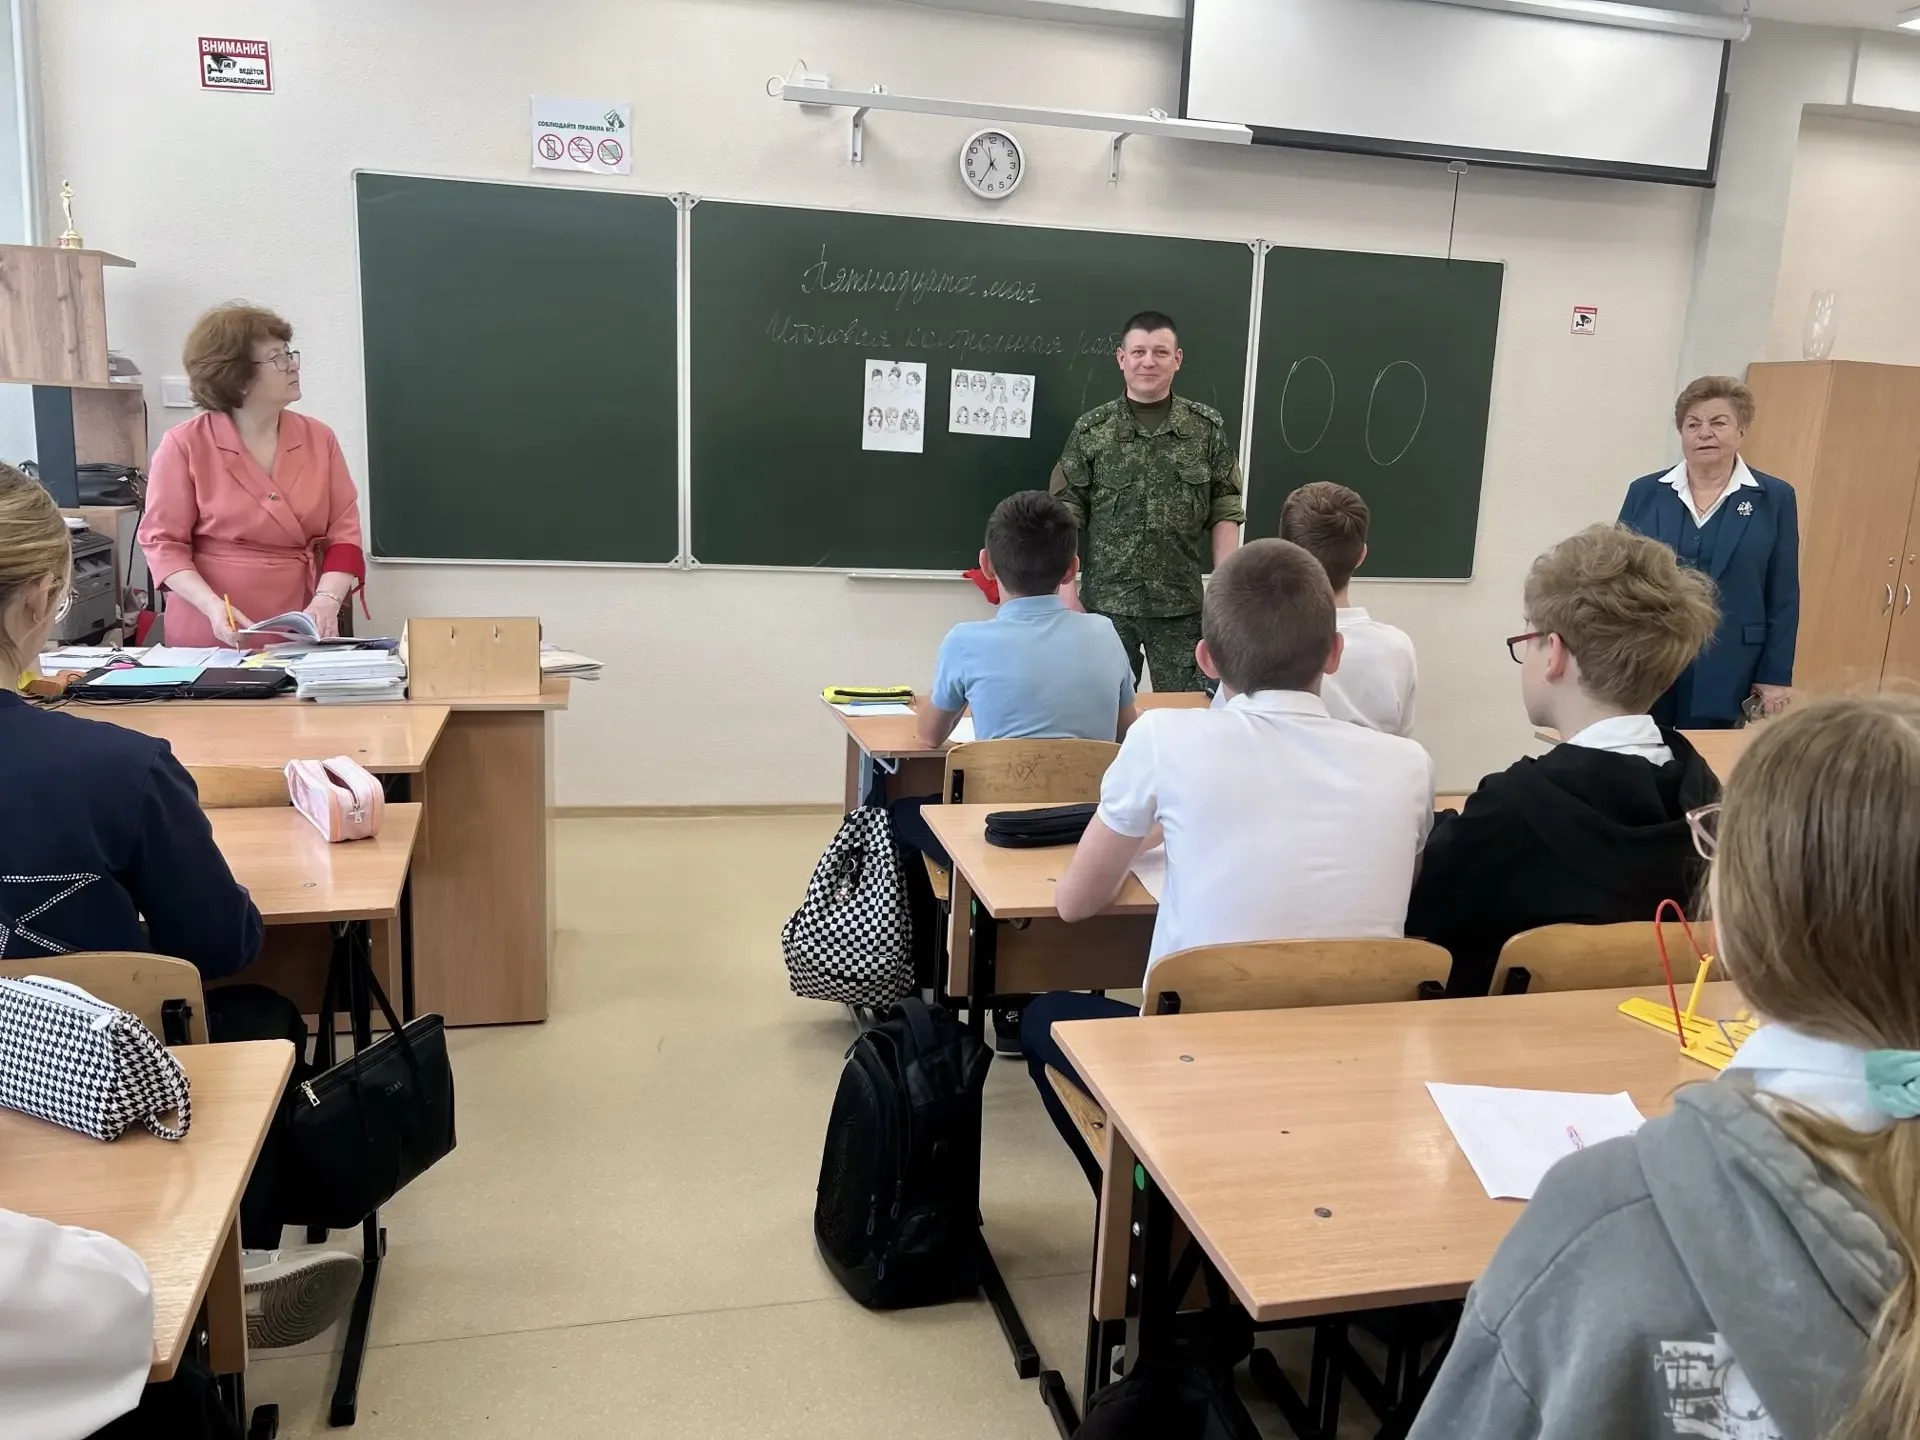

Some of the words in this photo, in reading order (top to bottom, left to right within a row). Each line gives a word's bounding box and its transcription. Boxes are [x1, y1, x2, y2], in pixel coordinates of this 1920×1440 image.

[201, 40, 266, 55] ВНИМАНИЕ
[207, 76, 265, 85] ВИДЕОНАБЛЮДЕНИЕ
[538, 121, 576, 130] СОБЛЮДАЙТЕ
[577, 124, 604, 132] ПРАВИЛА
[988, 136, 997, 145] 12
[1001, 140, 1005, 148] 1
[969, 146, 978, 155] 10
[1007, 149, 1014, 158] 2
[967, 158, 974, 167] 9
[1009, 161, 1016, 170] 3
[969, 170, 976, 179] 8
[1006, 173, 1013, 181] 4
[987, 183, 994, 192] 6
[998, 181, 1005, 189] 5
